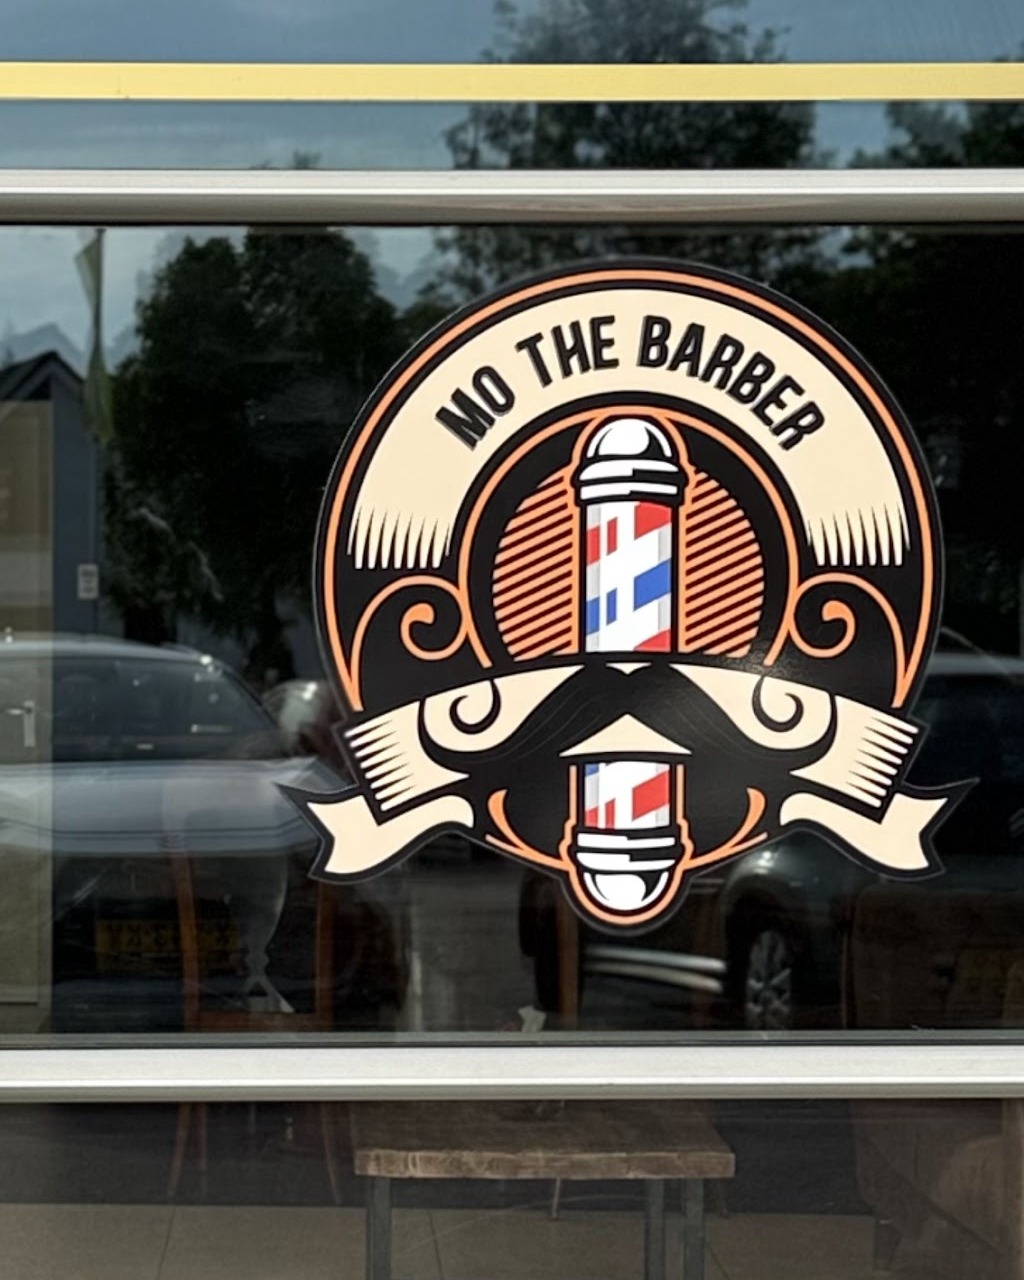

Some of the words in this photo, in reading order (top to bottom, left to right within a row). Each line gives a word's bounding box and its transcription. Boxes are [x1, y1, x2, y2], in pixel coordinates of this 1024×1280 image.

[435, 365, 516, 450] MO
[515, 315, 619, 387] THE
[637, 315, 825, 451] BARBER
